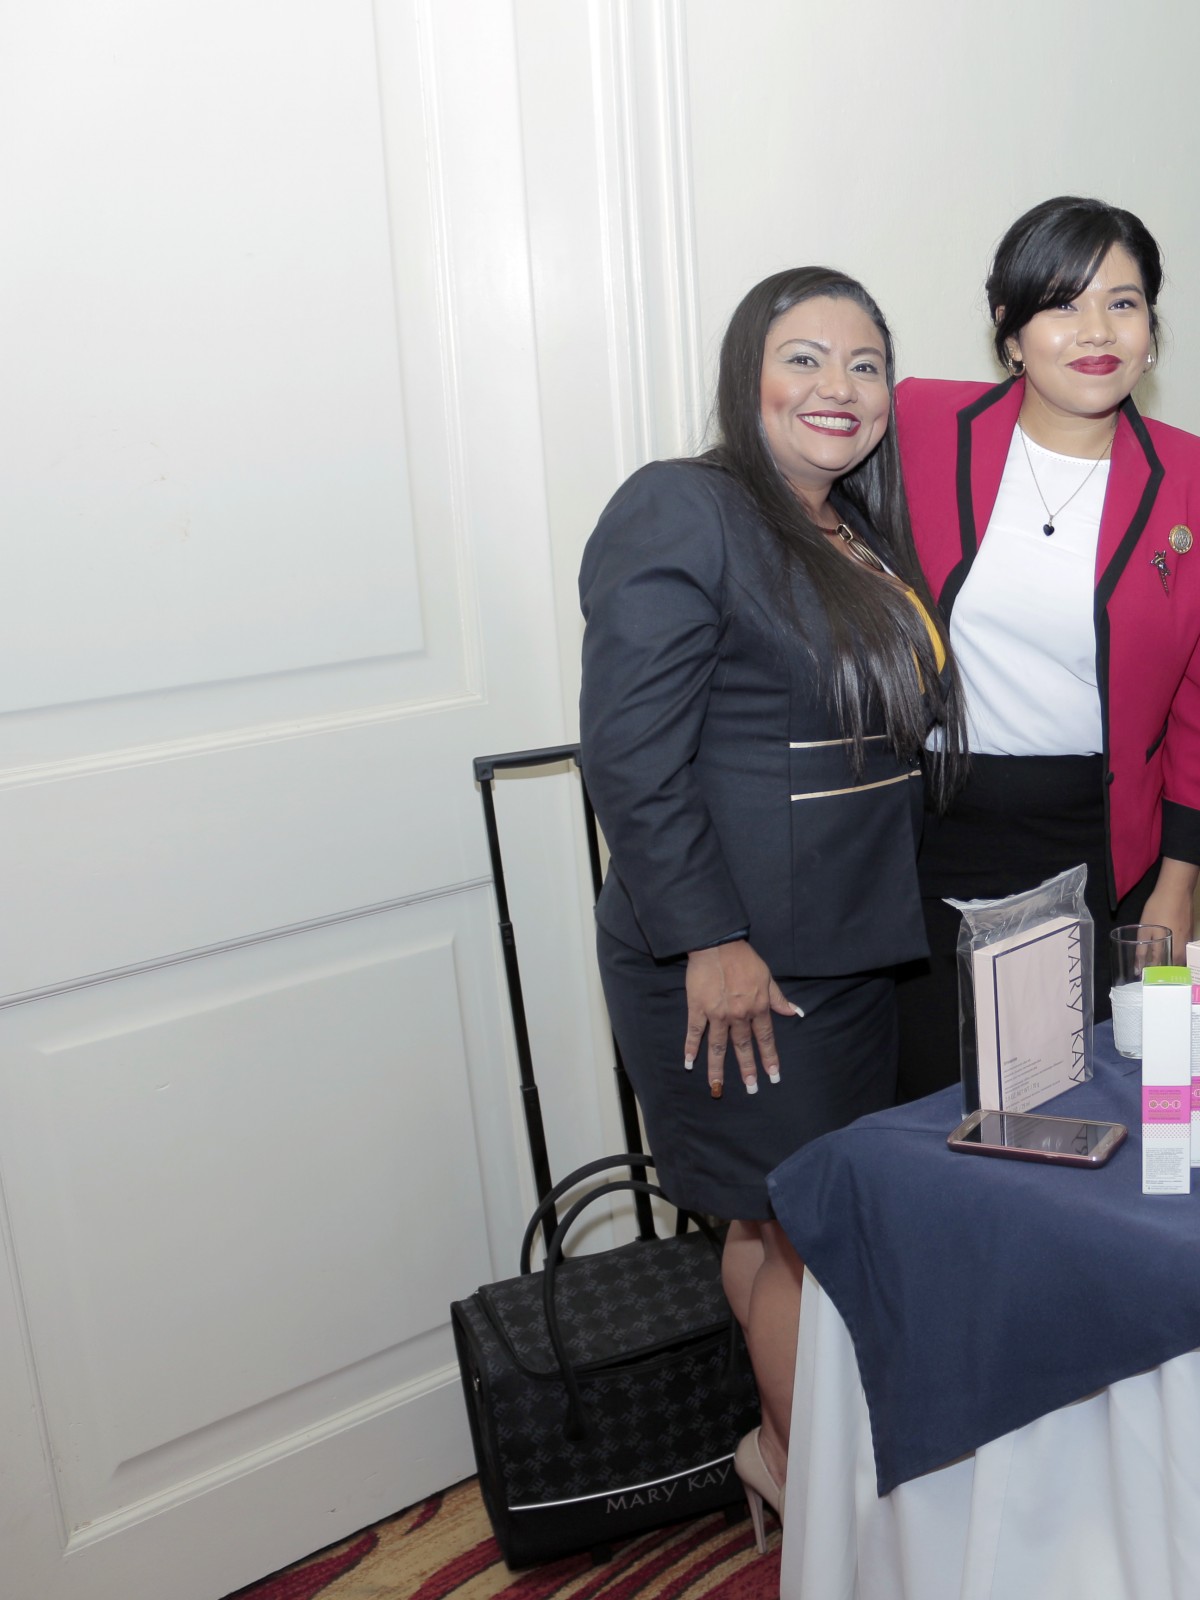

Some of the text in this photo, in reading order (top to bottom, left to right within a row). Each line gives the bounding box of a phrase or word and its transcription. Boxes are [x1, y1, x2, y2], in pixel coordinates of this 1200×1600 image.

[1066, 925, 1085, 1082] MARY KAY
[605, 1463, 732, 1514] MARY KAY
